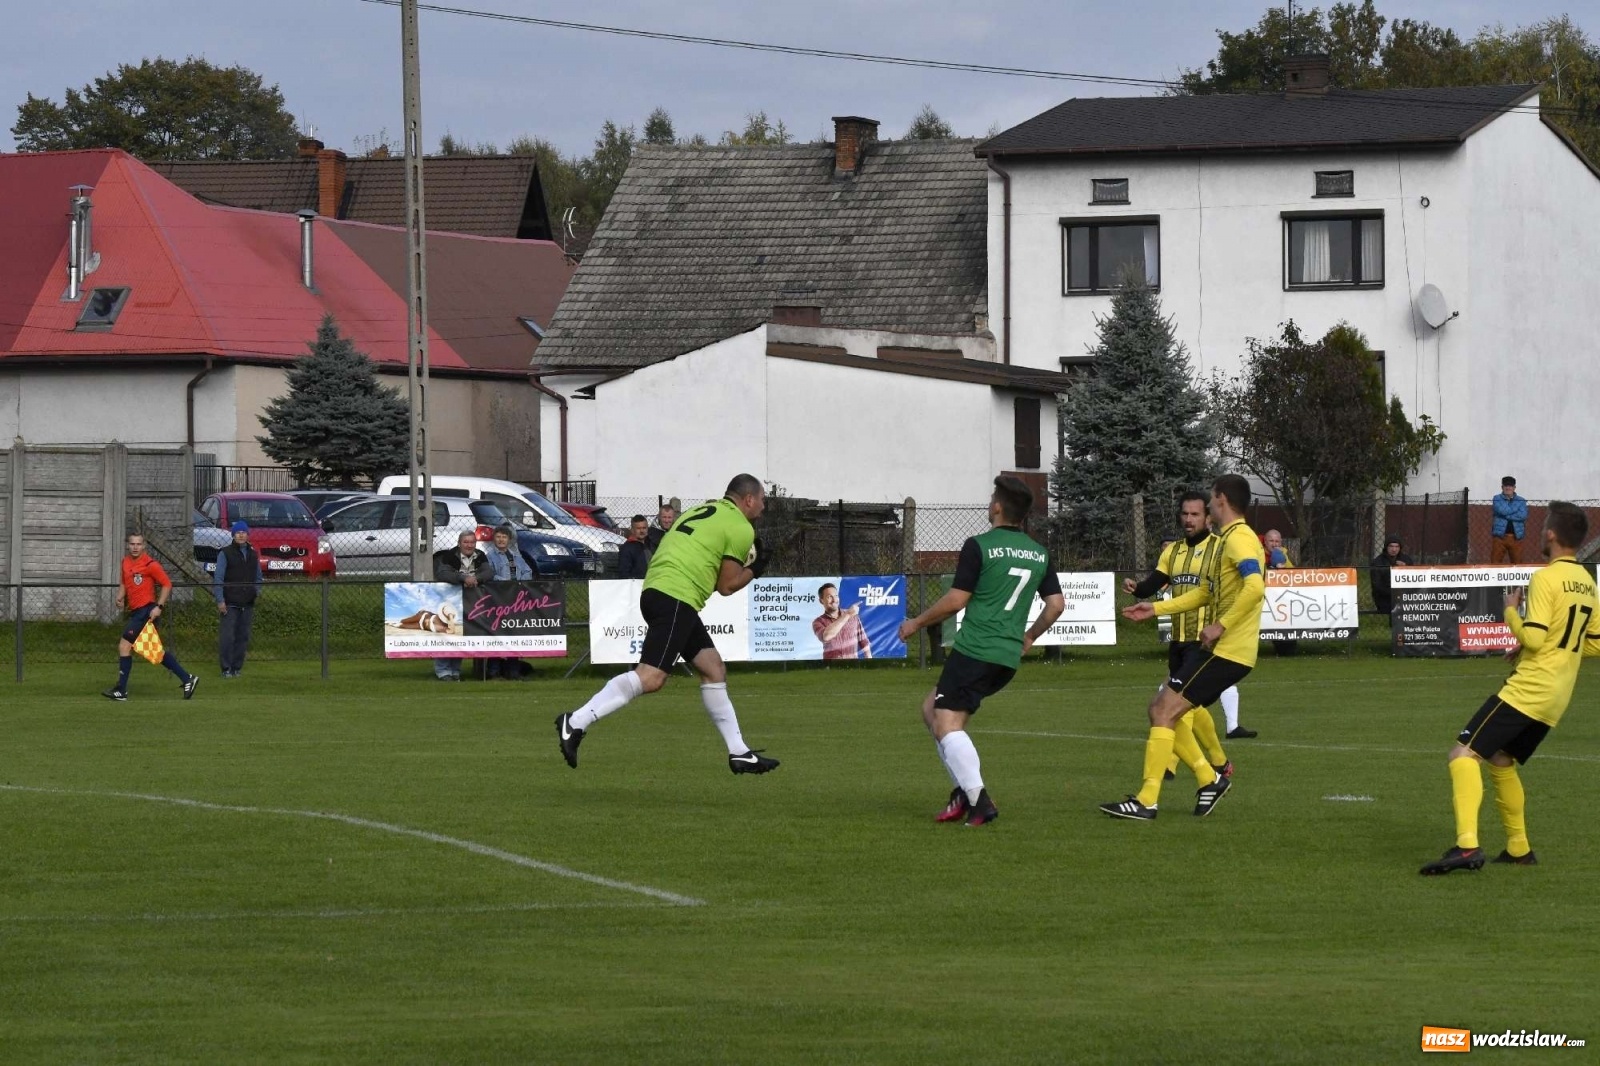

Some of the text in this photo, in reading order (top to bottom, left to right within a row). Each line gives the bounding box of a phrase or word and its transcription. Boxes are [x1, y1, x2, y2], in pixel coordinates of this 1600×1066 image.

[675, 505, 717, 536] 2
[988, 547, 1004, 559] LKS
[1267, 570, 1348, 587] Projektowe
[1394, 574, 1426, 583] USŁUGI
[1430, 573, 1490, 582] REMONTOWO
[1497, 572, 1533, 581] BUDOW
[753, 584, 793, 593] Podejmij
[1004, 567, 1032, 611] 7
[1562, 580, 1596, 598] LUBOMI
[753, 593, 816, 603] dobrą decyzję
[1402, 592, 1468, 601] BUDOWA DOMÓW
[468, 590, 561, 631] Ergoline
[759, 604, 788, 613] pracuj
[1402, 602, 1457, 611] WYKOŃCZENIA
[762, 614, 801, 622] Eko-Okna
[1402, 613, 1440, 622] REMONTY
[501, 618, 562, 629] SOLARIUM
[1557, 604, 1593, 653] 17
[603, 625, 635, 639] Wyślij
[704, 624, 735, 635] PRACA
[1047, 625, 1097, 635] PIEKARNIA
[1466, 626, 1512, 635] WYNAJEM
[1260, 630, 1350, 641] omia, ul. Asnyka 69
[629, 640, 643, 654] 53
[1461, 636, 1517, 647] SZALUNKÓW
